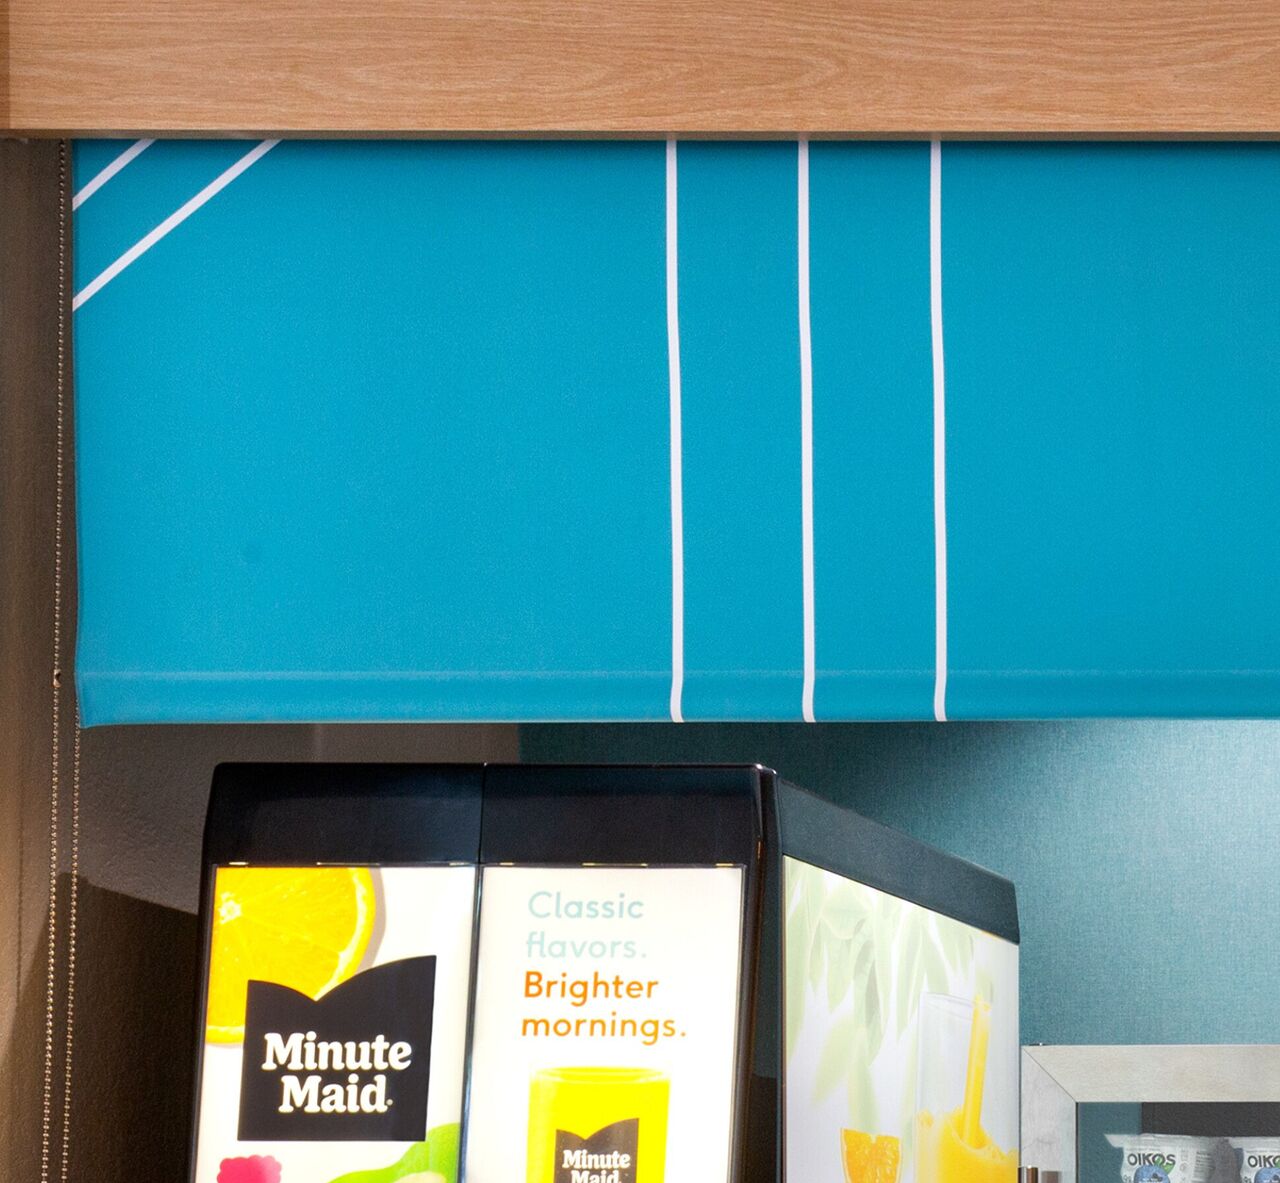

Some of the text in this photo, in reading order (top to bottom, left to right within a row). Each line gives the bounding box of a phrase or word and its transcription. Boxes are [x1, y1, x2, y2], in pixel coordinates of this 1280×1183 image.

[528, 890, 644, 919] Classic
[526, 931, 646, 958] flavors.
[524, 971, 659, 1007] Brighter
[521, 1011, 686, 1046] mornings.
[261, 1031, 412, 1070] Minute
[278, 1073, 391, 1113] Maid
[562, 1149, 631, 1169] Minute
[1128, 1153, 1176, 1166] OIKOS
